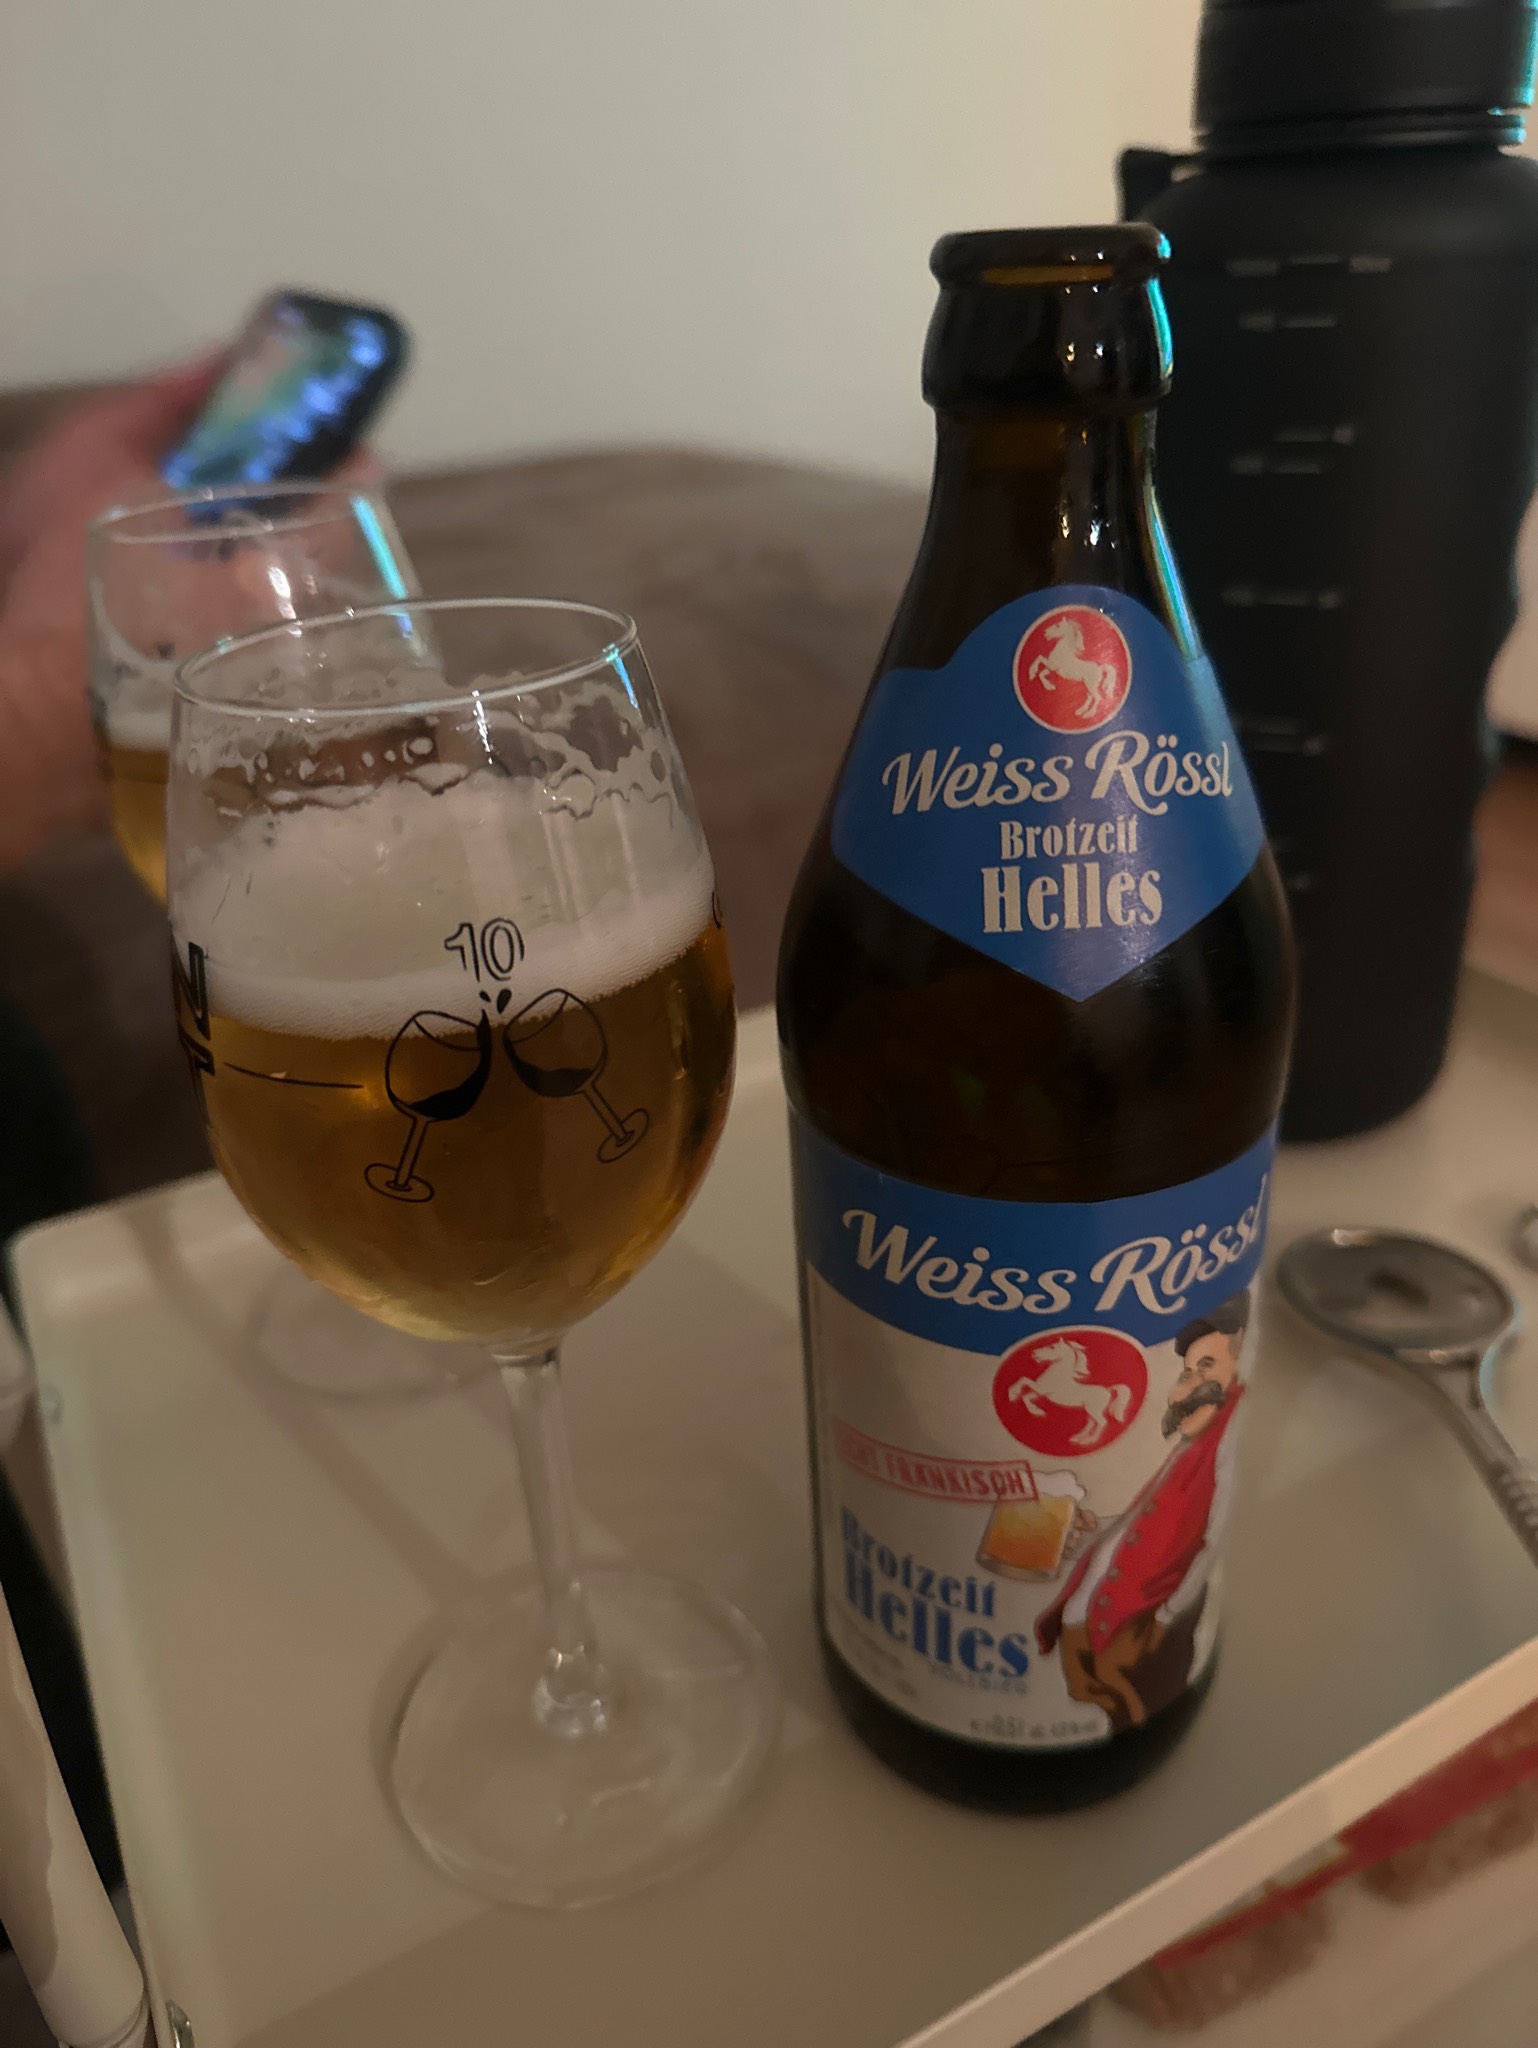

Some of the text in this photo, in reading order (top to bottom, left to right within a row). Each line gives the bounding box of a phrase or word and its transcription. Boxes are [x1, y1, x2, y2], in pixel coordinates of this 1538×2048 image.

[881, 742, 1073, 815] Weiss
[1084, 729, 1234, 816] Rössl
[999, 816, 1139, 861] Brotzeit
[980, 861, 1164, 935] Helles
[444, 918, 525, 981] 10
[841, 1172, 1269, 1316] Weiss Rössl
[840, 1504, 997, 1619] Brotzeit
[844, 1549, 1031, 1680] Helles
